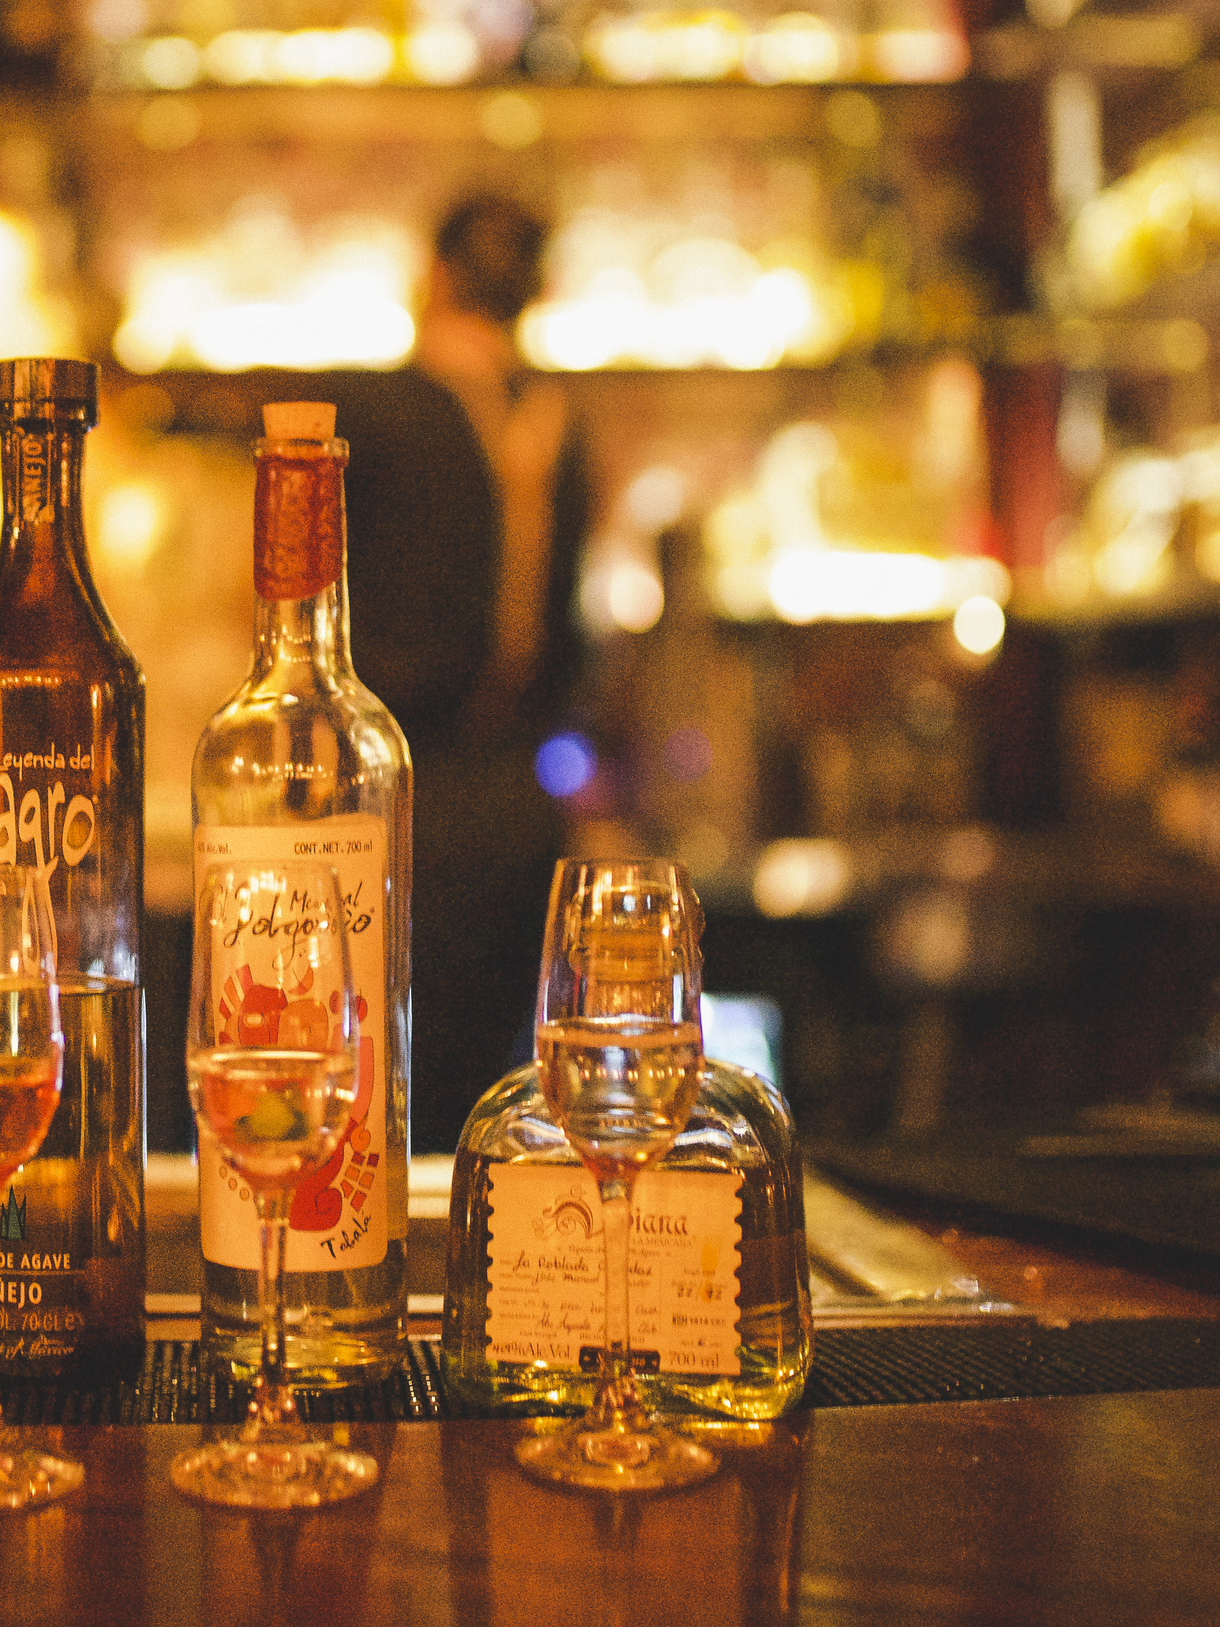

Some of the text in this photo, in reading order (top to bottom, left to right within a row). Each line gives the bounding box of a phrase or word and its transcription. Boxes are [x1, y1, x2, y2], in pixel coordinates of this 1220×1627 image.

[70, 743, 95, 771] del
[20, 1253, 71, 1270] AGAVE
[668, 1350, 696, 1367] 700
